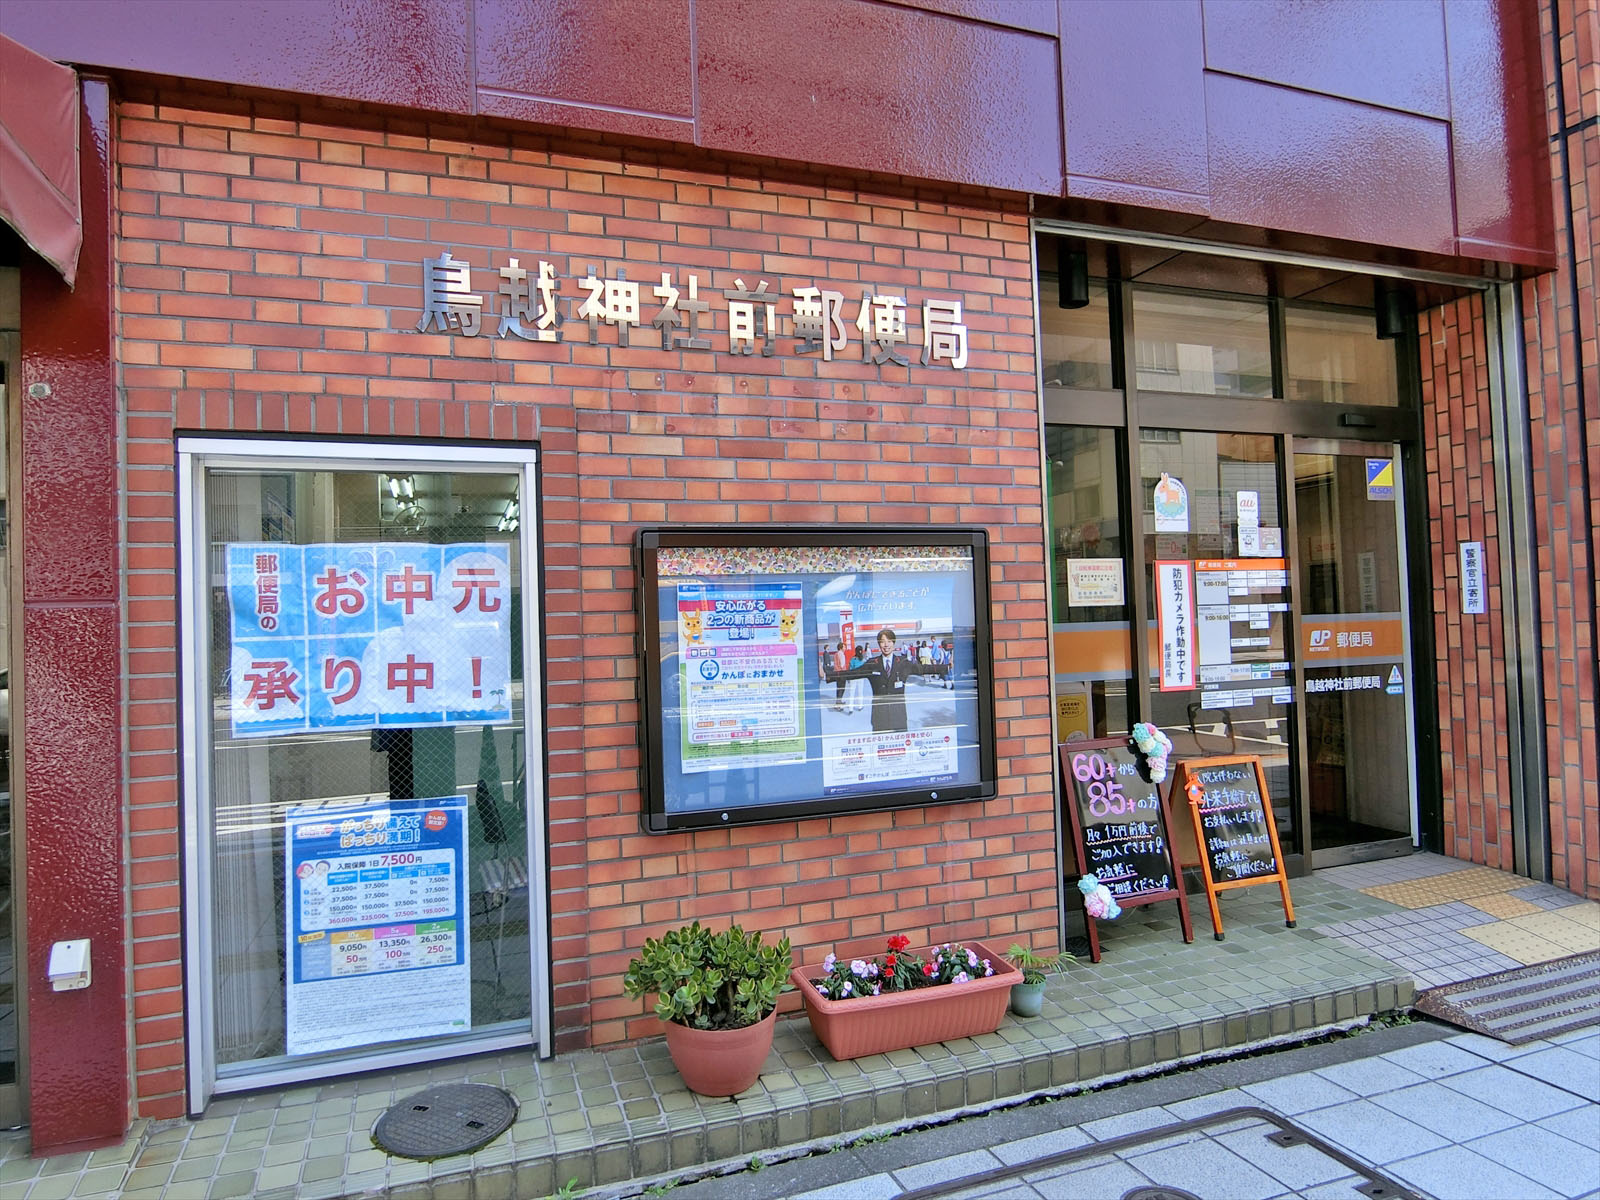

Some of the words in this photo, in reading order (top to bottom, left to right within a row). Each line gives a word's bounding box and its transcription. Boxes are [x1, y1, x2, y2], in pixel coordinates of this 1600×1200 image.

[414, 251, 969, 370] 鳥越神社前郵便局
[1466, 548, 1478, 607] 警察官立寄所
[255, 554, 278, 630] 郵便局の
[314, 566, 501, 615] お中元
[715, 600, 766, 612] 安心広がる
[707, 613, 776, 626] 2つの新商品が
[1172, 568, 1186, 683] 防犯カメラ作動中です
[729, 628, 755, 640] 登場!
[1310, 630, 1331, 646] JP
[1336, 632, 1373, 648] 郵便局
[243, 654, 482, 711] 承り中!
[721, 670, 784, 680] かんぽにおまかせ
[1305, 675, 1380, 693] 鳥越神社前郵便局
[340, 829, 421, 848] ばっちり満期!
[337, 860, 366, 871] 入院保障
[1096, 863, 1136, 879] お気軽に
[1107, 875, 1169, 895] ご相談ください!
